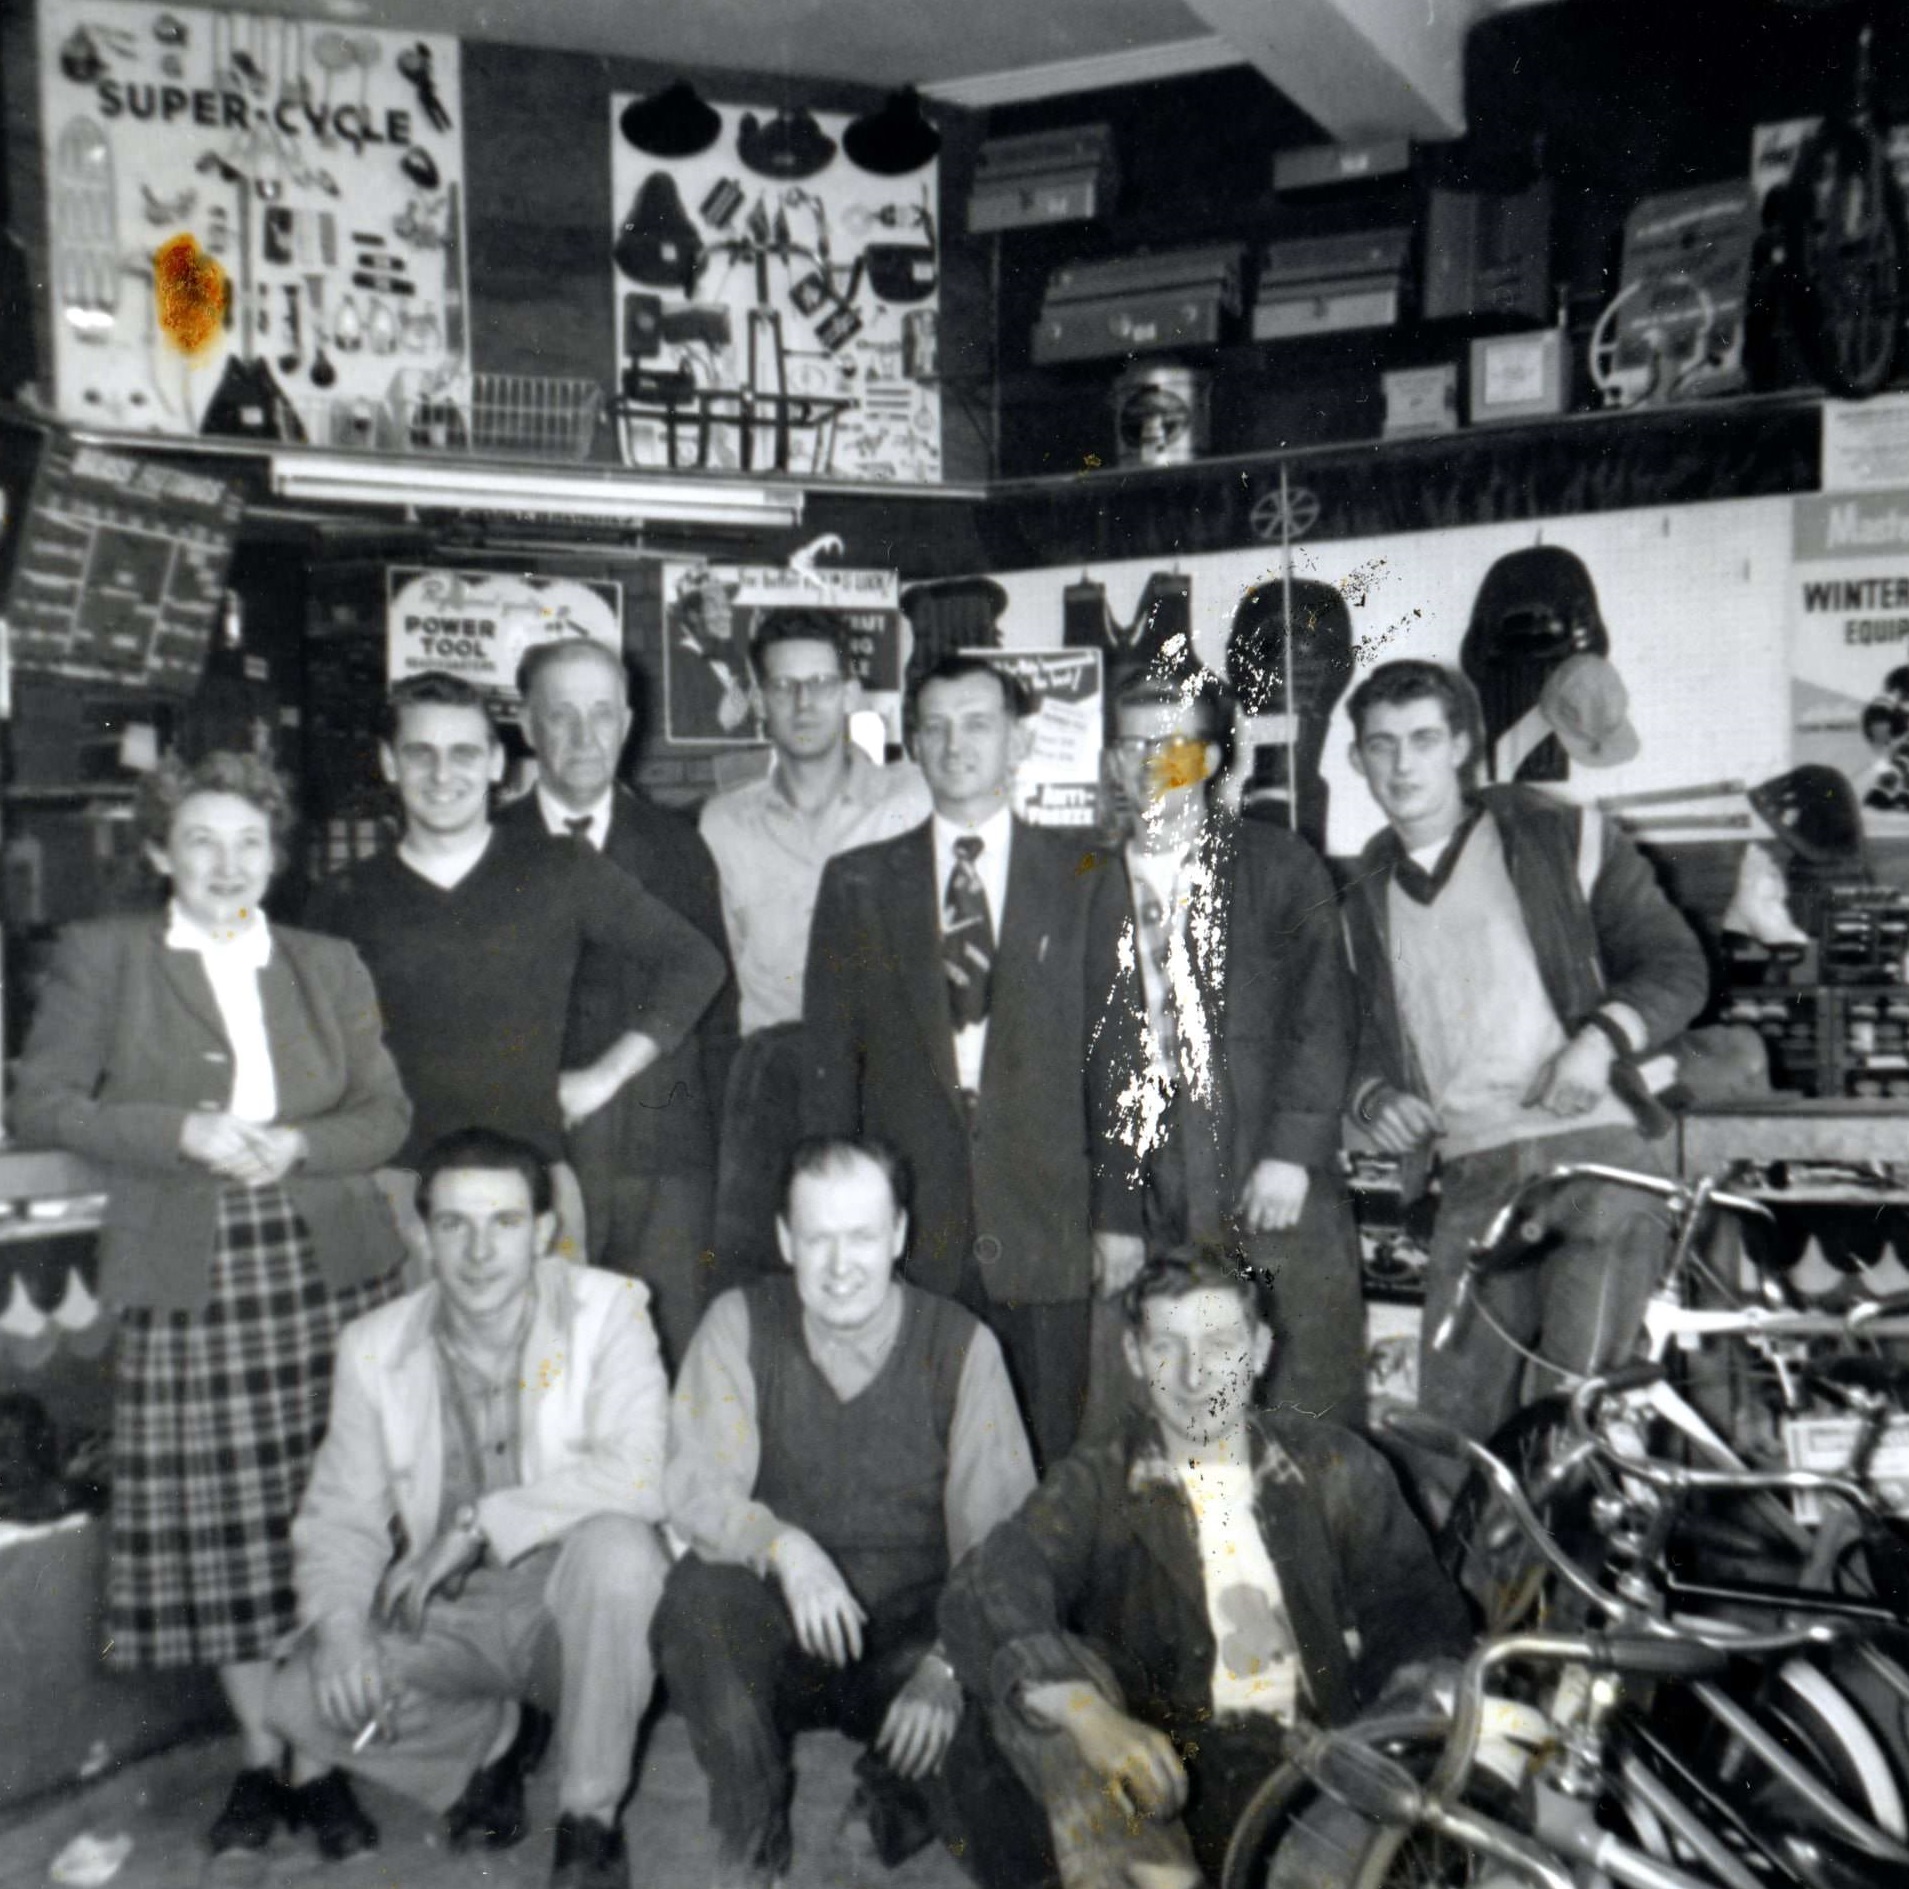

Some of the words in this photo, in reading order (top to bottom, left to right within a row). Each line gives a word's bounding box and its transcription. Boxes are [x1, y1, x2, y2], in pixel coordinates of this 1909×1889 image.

[1804, 578, 1909, 613] WINTER
[405, 616, 495, 639] POWER
[420, 637, 487, 658] TOOL
